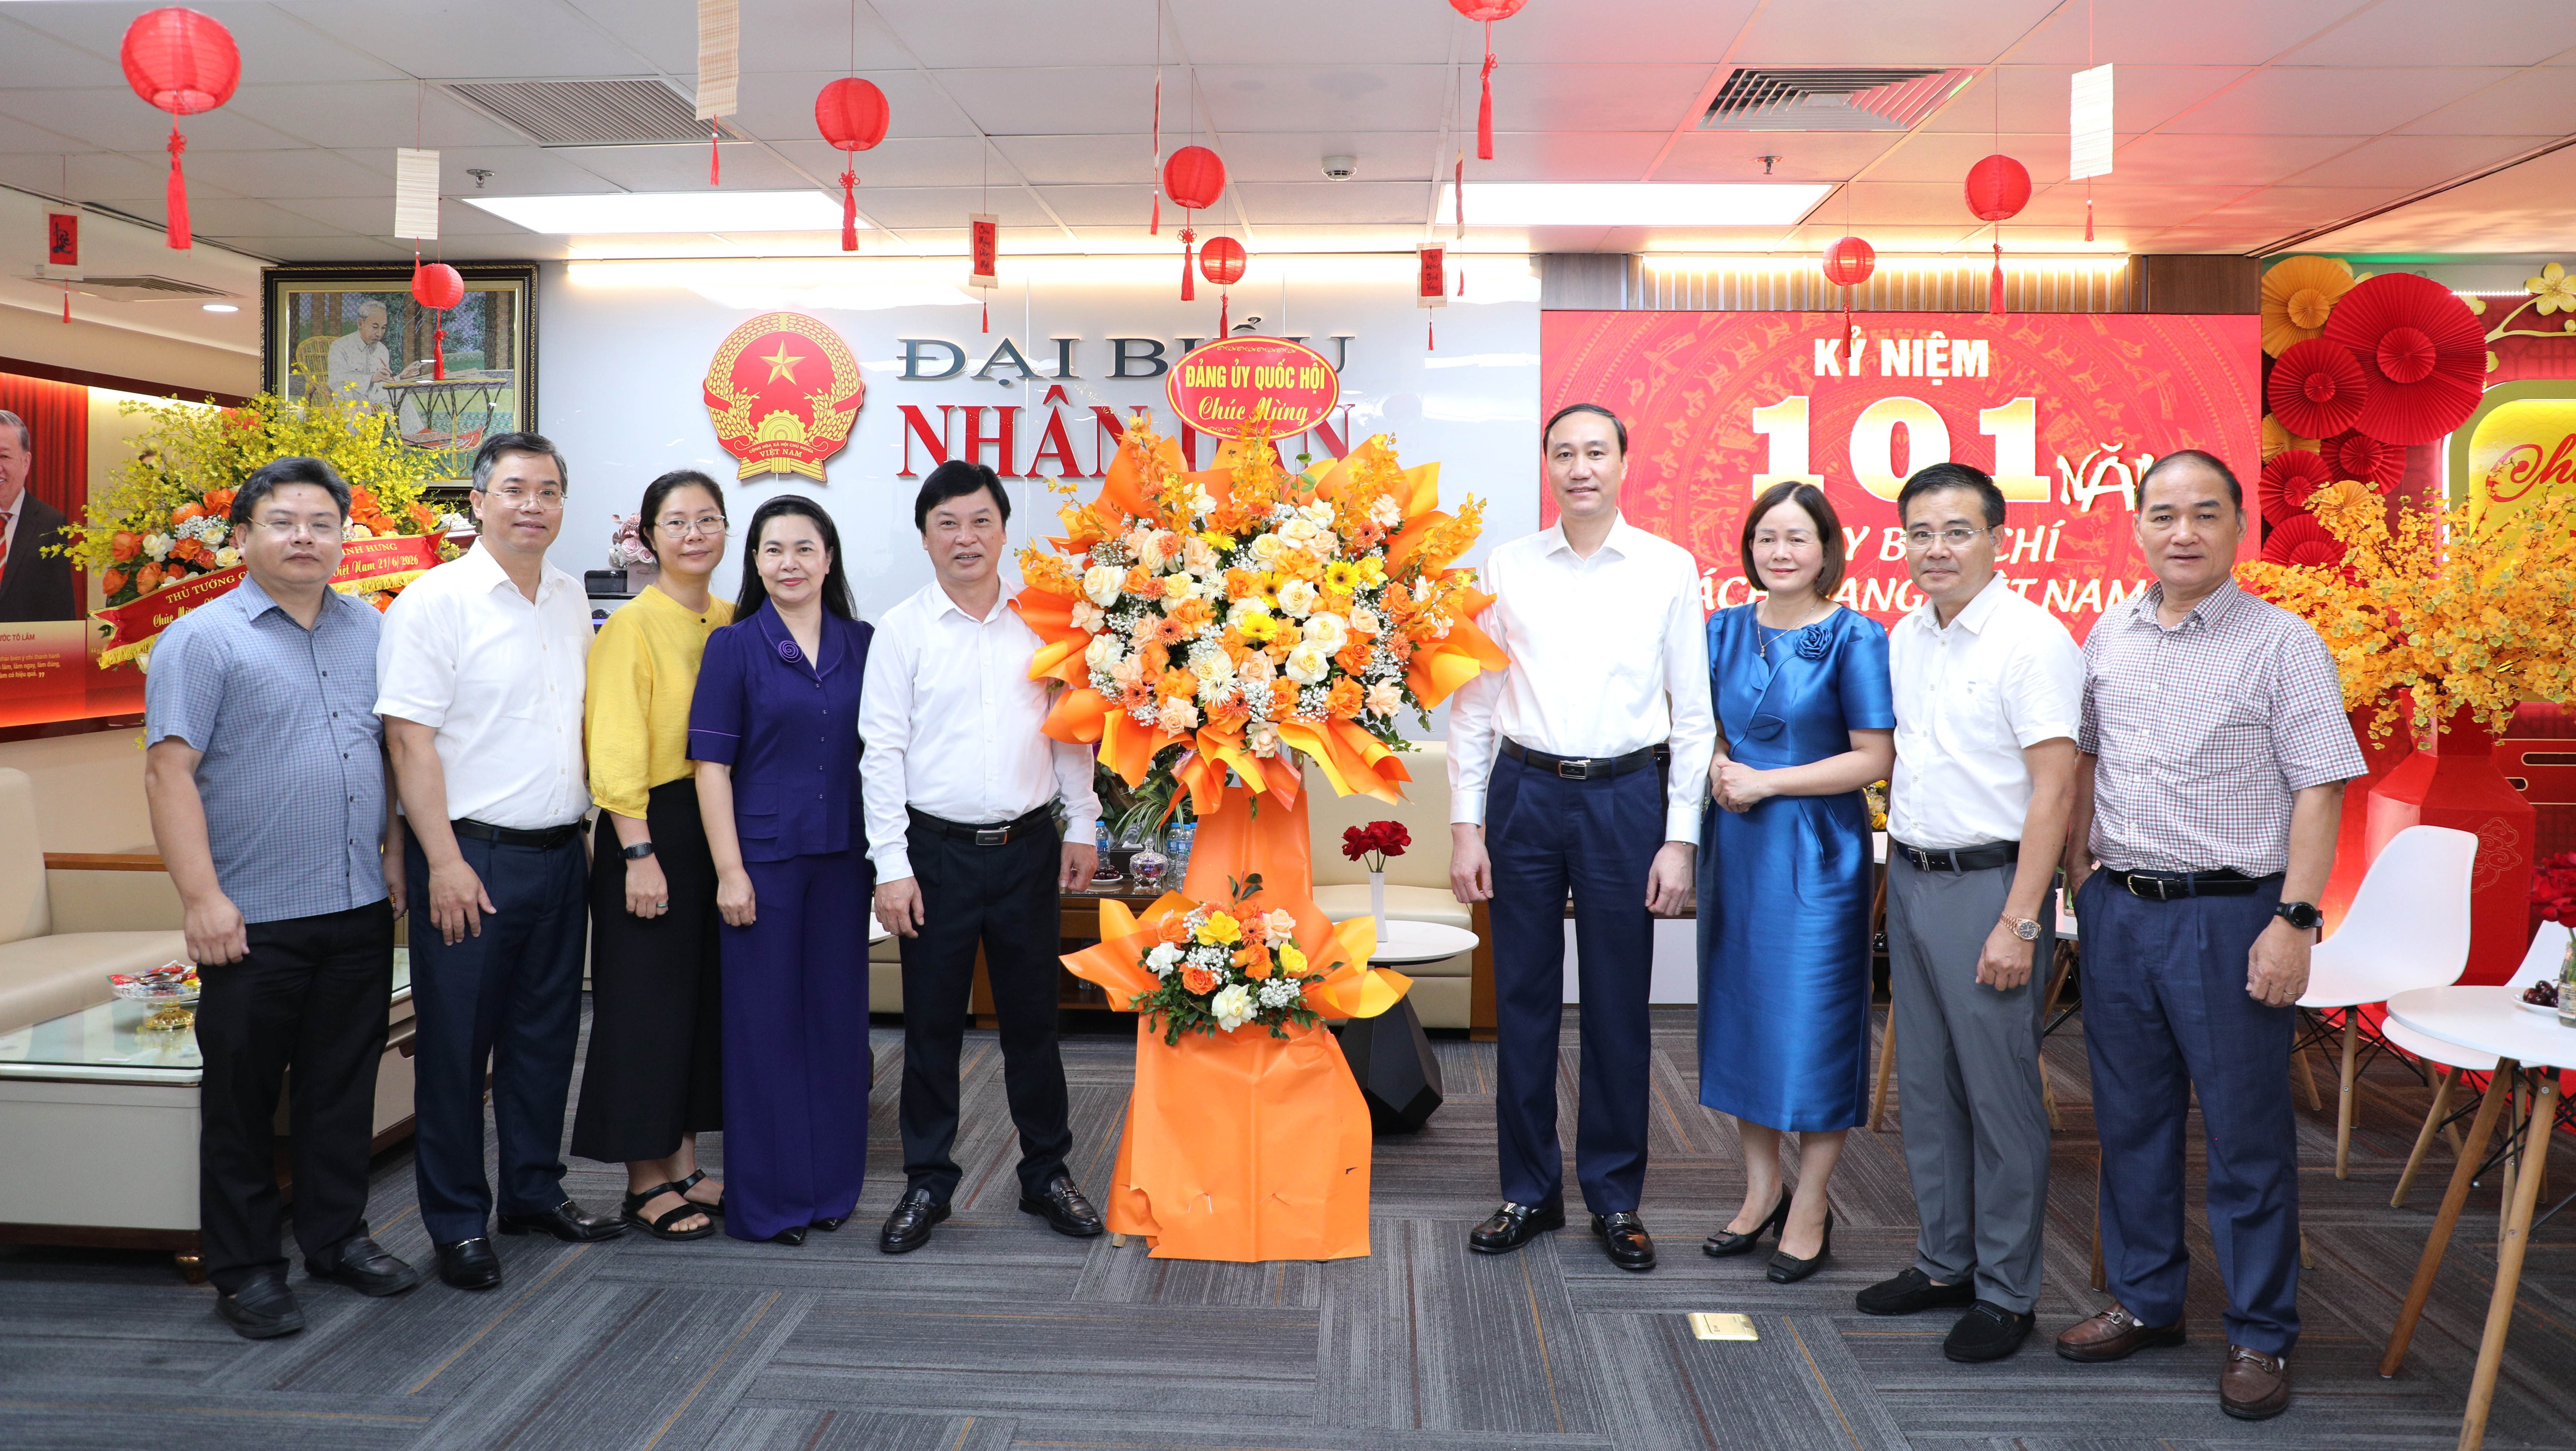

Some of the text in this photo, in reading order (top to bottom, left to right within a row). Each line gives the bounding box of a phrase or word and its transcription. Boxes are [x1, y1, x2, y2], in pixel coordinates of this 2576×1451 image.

[896, 337, 1080, 386] ĐẠI
[1881, 332, 1989, 385] NIỆM
[1185, 358, 1325, 394] ĐẢNG ỦY QUỐC HỘI
[1198, 396, 1309, 427] Chúc Mừng
[896, 384, 1149, 478] NHÂN
[749, 446, 761, 454] CỘNG
[800, 446, 814, 454] NGHĨA
[759, 448, 802, 458] VIỆT NAM
[2057, 442, 2155, 512] NĂ
[342, 543, 398, 555] INH HƯNG
[352, 560, 376, 573] Nam
[401, 554, 419, 566] 2026
[166, 586, 190, 604] THỦ
[192, 575, 236, 595] TƯỚNG
[12, 632, 20, 641] TÔ
[22, 632, 35, 640] LÂM
